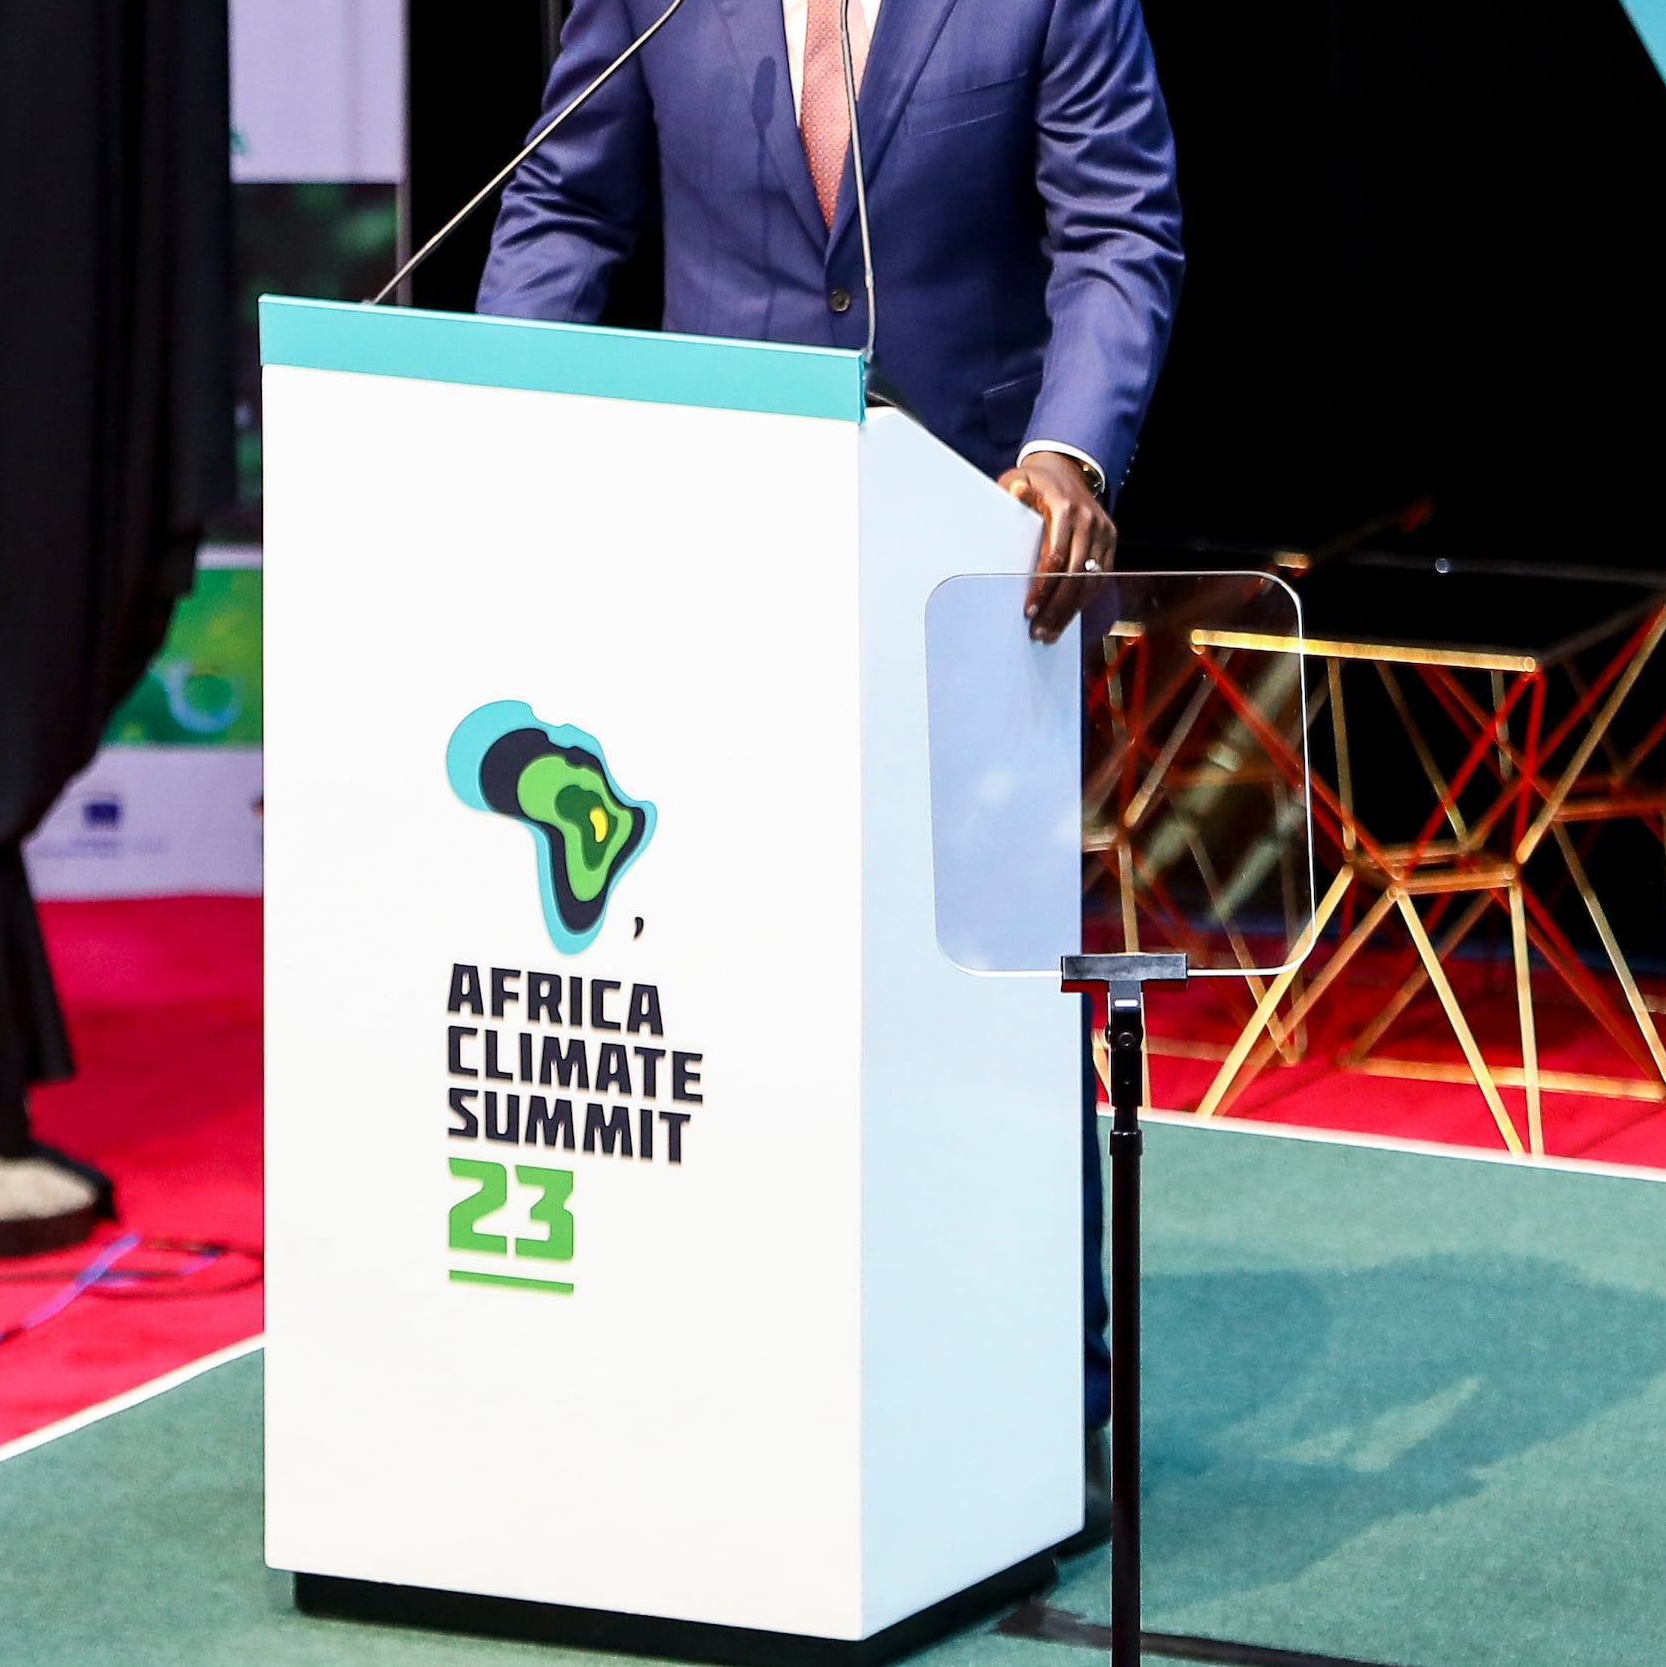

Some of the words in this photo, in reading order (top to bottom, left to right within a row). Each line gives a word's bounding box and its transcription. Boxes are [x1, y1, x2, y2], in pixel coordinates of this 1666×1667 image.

[448, 963, 664, 1038] AFRICA
[448, 1025, 703, 1105] CLIMATE
[448, 1087, 691, 1165] SUMMIT
[448, 1156, 574, 1262] 23
